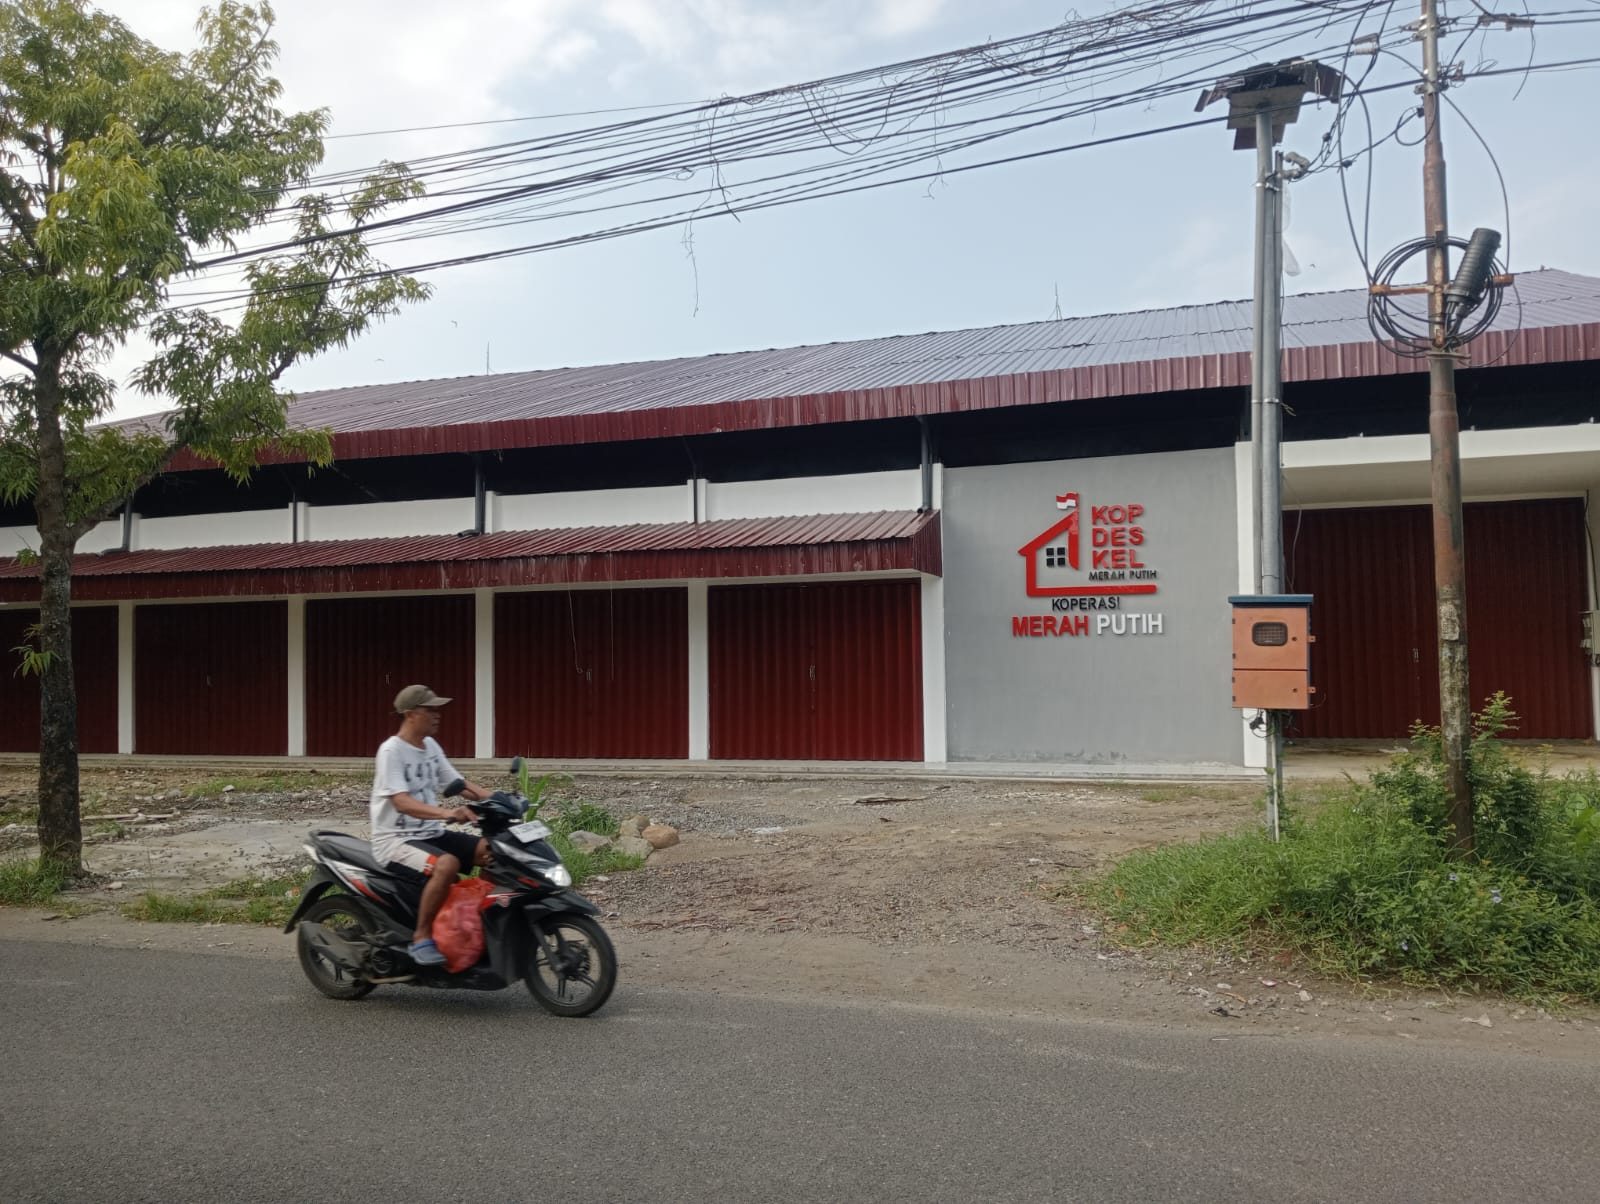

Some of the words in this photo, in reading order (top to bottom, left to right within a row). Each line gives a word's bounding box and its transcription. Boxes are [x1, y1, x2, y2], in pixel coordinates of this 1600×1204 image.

[1091, 504, 1144, 525] KOP
[1092, 527, 1144, 547] DES
[1092, 549, 1145, 569] KEL
[1089, 571, 1125, 581] MERAH
[1129, 570, 1157, 580] PUTIH
[1052, 596, 1120, 611] KOPERASI
[1012, 615, 1089, 637] MERAH
[1097, 613, 1163, 635] PUTIH
